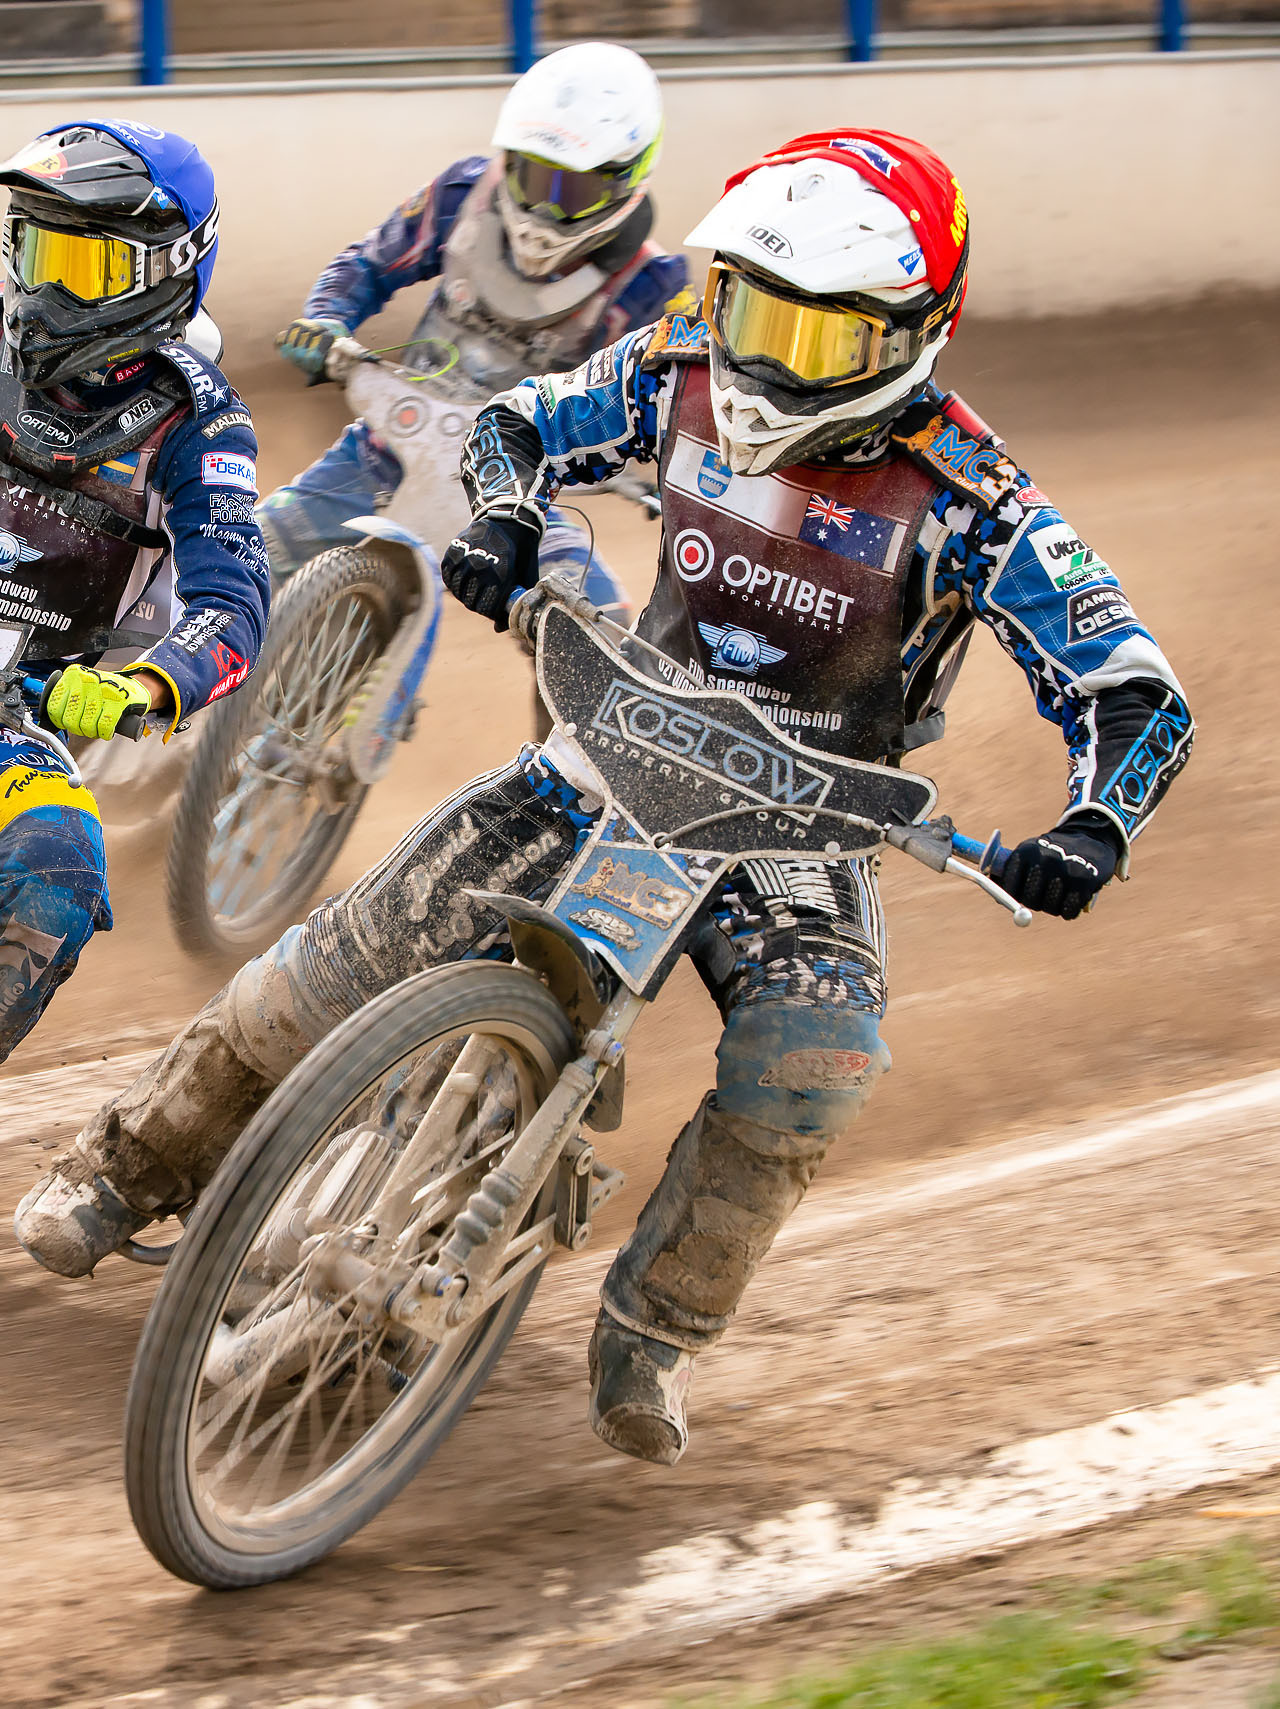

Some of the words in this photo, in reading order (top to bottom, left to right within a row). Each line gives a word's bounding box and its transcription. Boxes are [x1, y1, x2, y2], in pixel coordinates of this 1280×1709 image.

[160, 347, 214, 396] STAR
[197, 394, 208, 413] FM
[20, 413, 70, 445] ORTEMA
[718, 583, 784, 617] SPORTA
[722, 554, 855, 625] OPTIBET
[722, 640, 755, 664] FIM
[706, 674, 792, 704] Speedway
[756, 703, 843, 732] pionship
[583, 729, 706, 791] PROPERTY
[594, 685, 823, 805] KOSLOW
